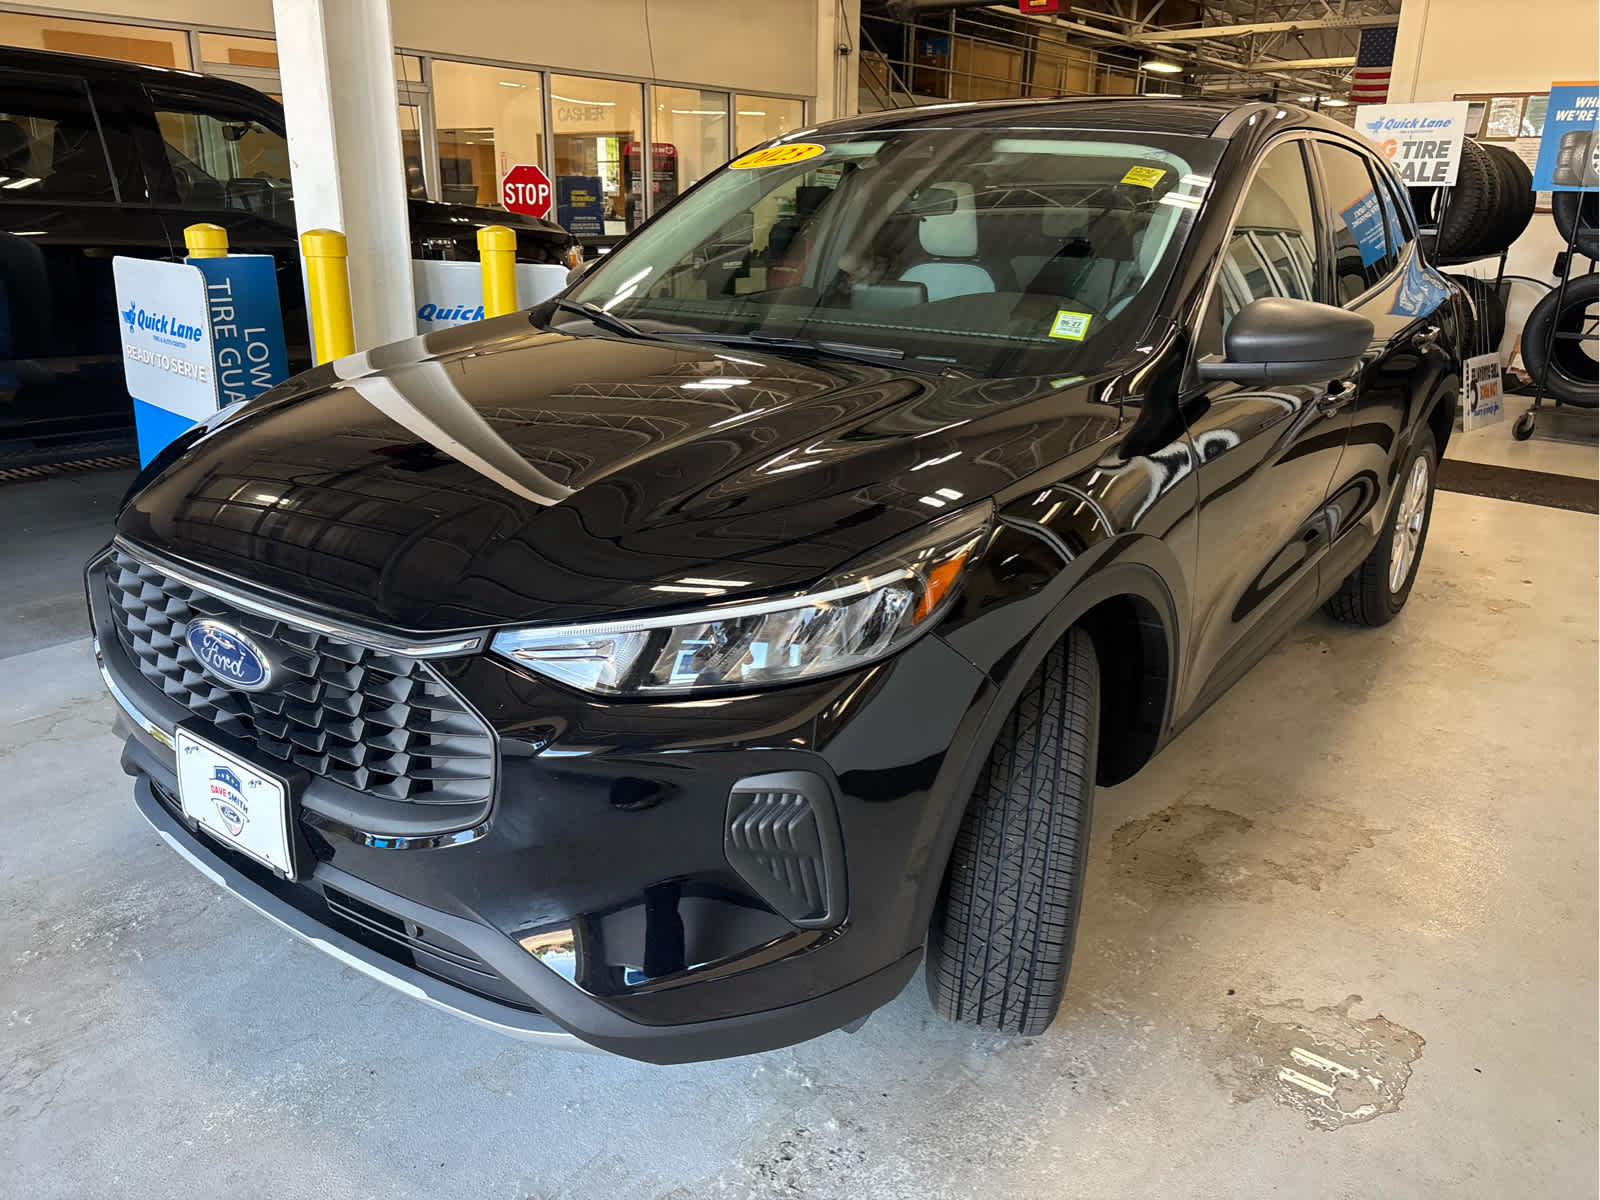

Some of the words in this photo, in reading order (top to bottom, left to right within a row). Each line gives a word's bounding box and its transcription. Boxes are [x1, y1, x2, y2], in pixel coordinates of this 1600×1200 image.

[1384, 118, 1418, 130] Quick
[1420, 118, 1451, 129] Lane
[1555, 109, 1596, 121] WE'RE
[1402, 140, 1452, 159] TIRE
[505, 183, 549, 205] STOP
[208, 277, 238, 340] TIRE
[417, 303, 485, 322] Quick
[137, 309, 168, 334] Quick
[170, 317, 202, 342] Lane
[127, 344, 155, 367] READY
[155, 353, 170, 371] TO
[171, 357, 207, 383] SERVE
[244, 328, 273, 388] LOW
[200, 634, 246, 677] Ford
[227, 791, 249, 815] SMITH
